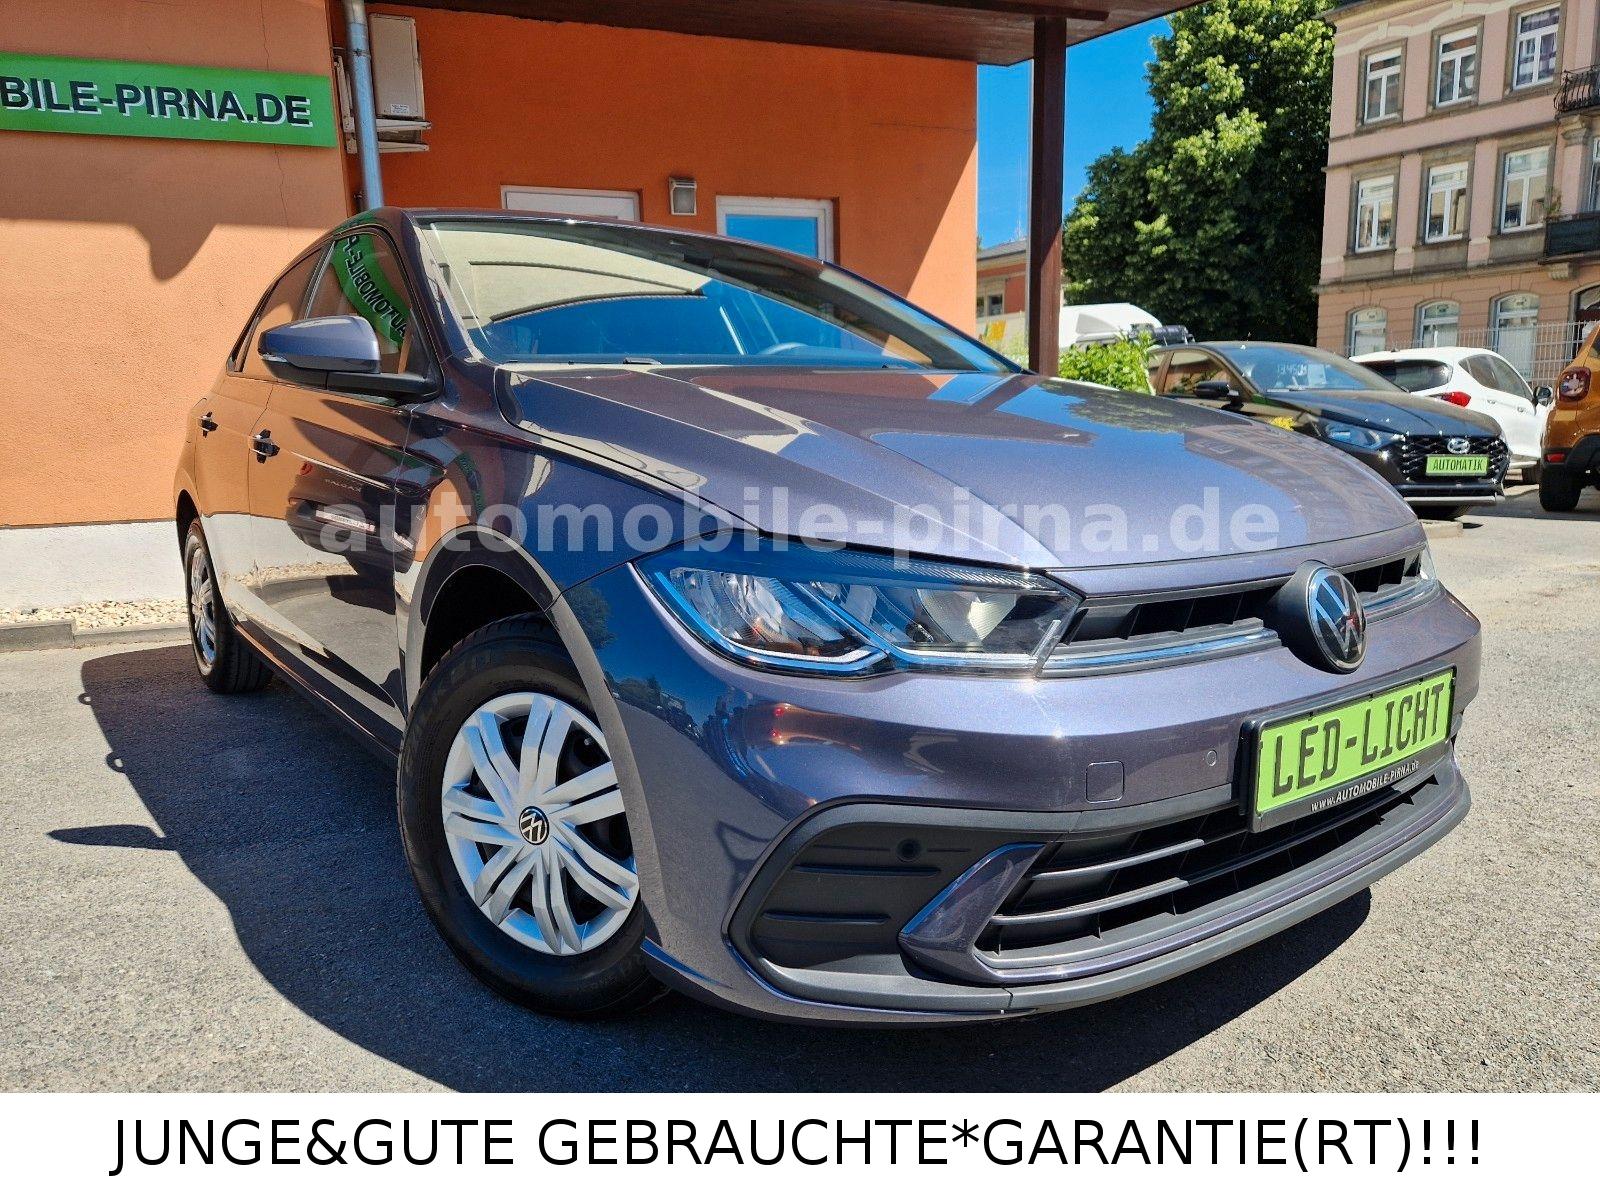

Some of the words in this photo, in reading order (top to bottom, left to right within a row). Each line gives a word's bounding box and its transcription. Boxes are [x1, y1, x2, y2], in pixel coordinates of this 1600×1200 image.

[0, 75, 313, 128] BILE-PIRNA.DE
[1432, 458, 1483, 471] AUTOMATIK
[1272, 682, 1445, 798] LED-LICHT
